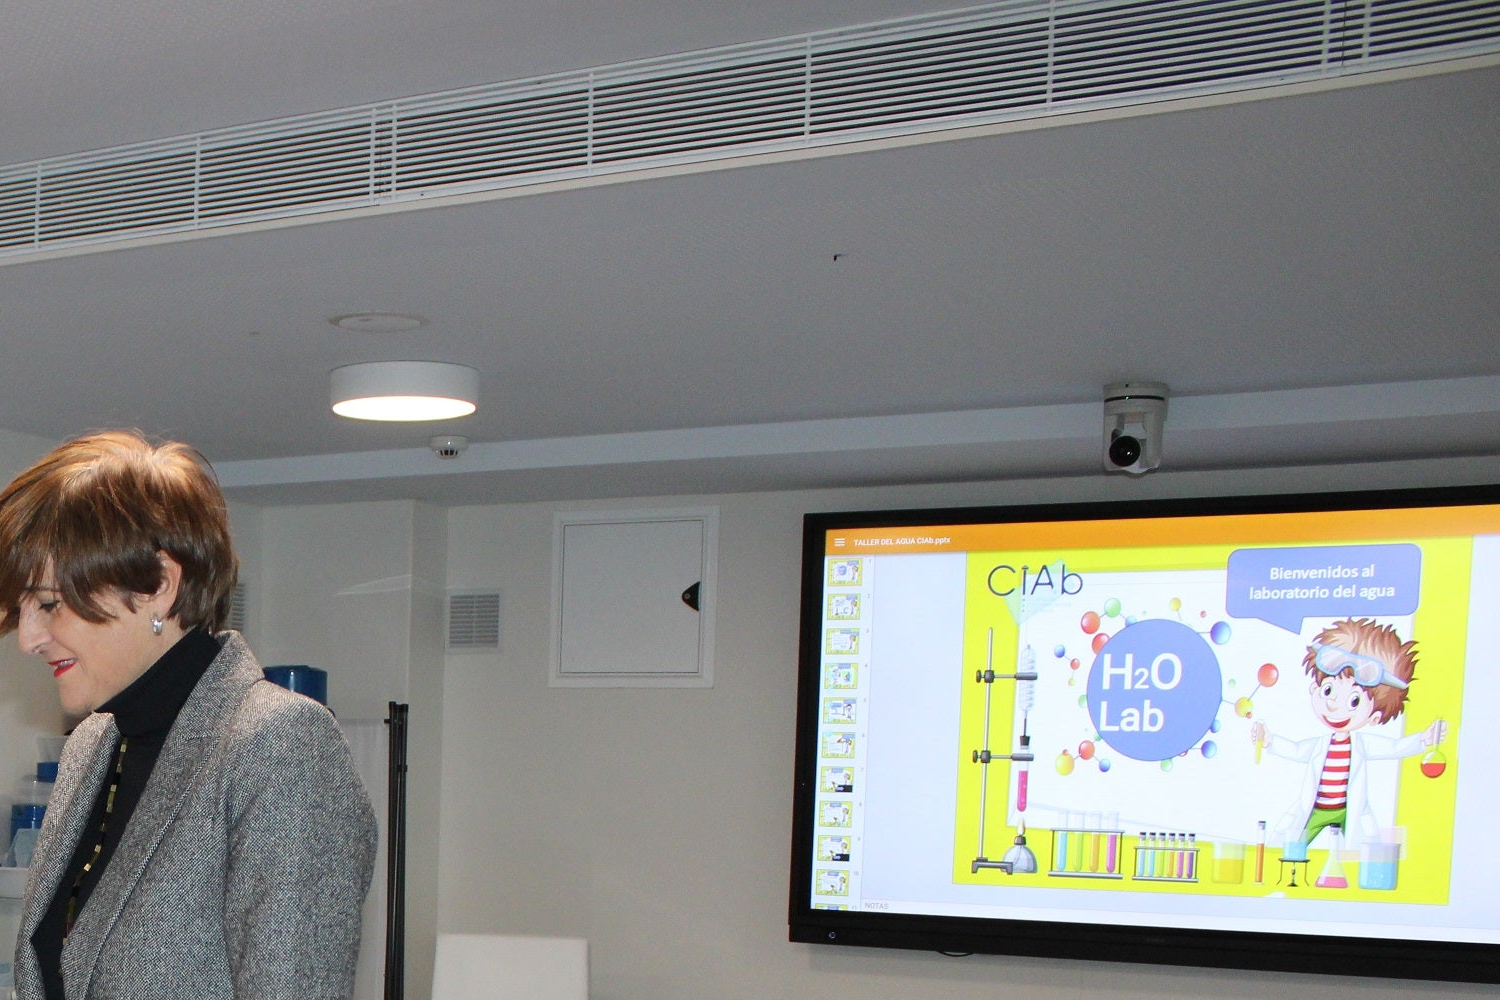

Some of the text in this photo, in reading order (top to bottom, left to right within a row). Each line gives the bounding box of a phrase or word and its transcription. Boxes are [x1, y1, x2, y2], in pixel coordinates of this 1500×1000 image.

[854, 538, 880, 546] TALLER
[880, 538, 894, 546] DEL
[895, 537, 915, 545] AGUA
[1269, 563, 1375, 580] Bienvenidos al
[1249, 584, 1396, 601] laboratorio del agua
[1099, 699, 1165, 733] Lab
[864, 902, 890, 910] NOTAS
